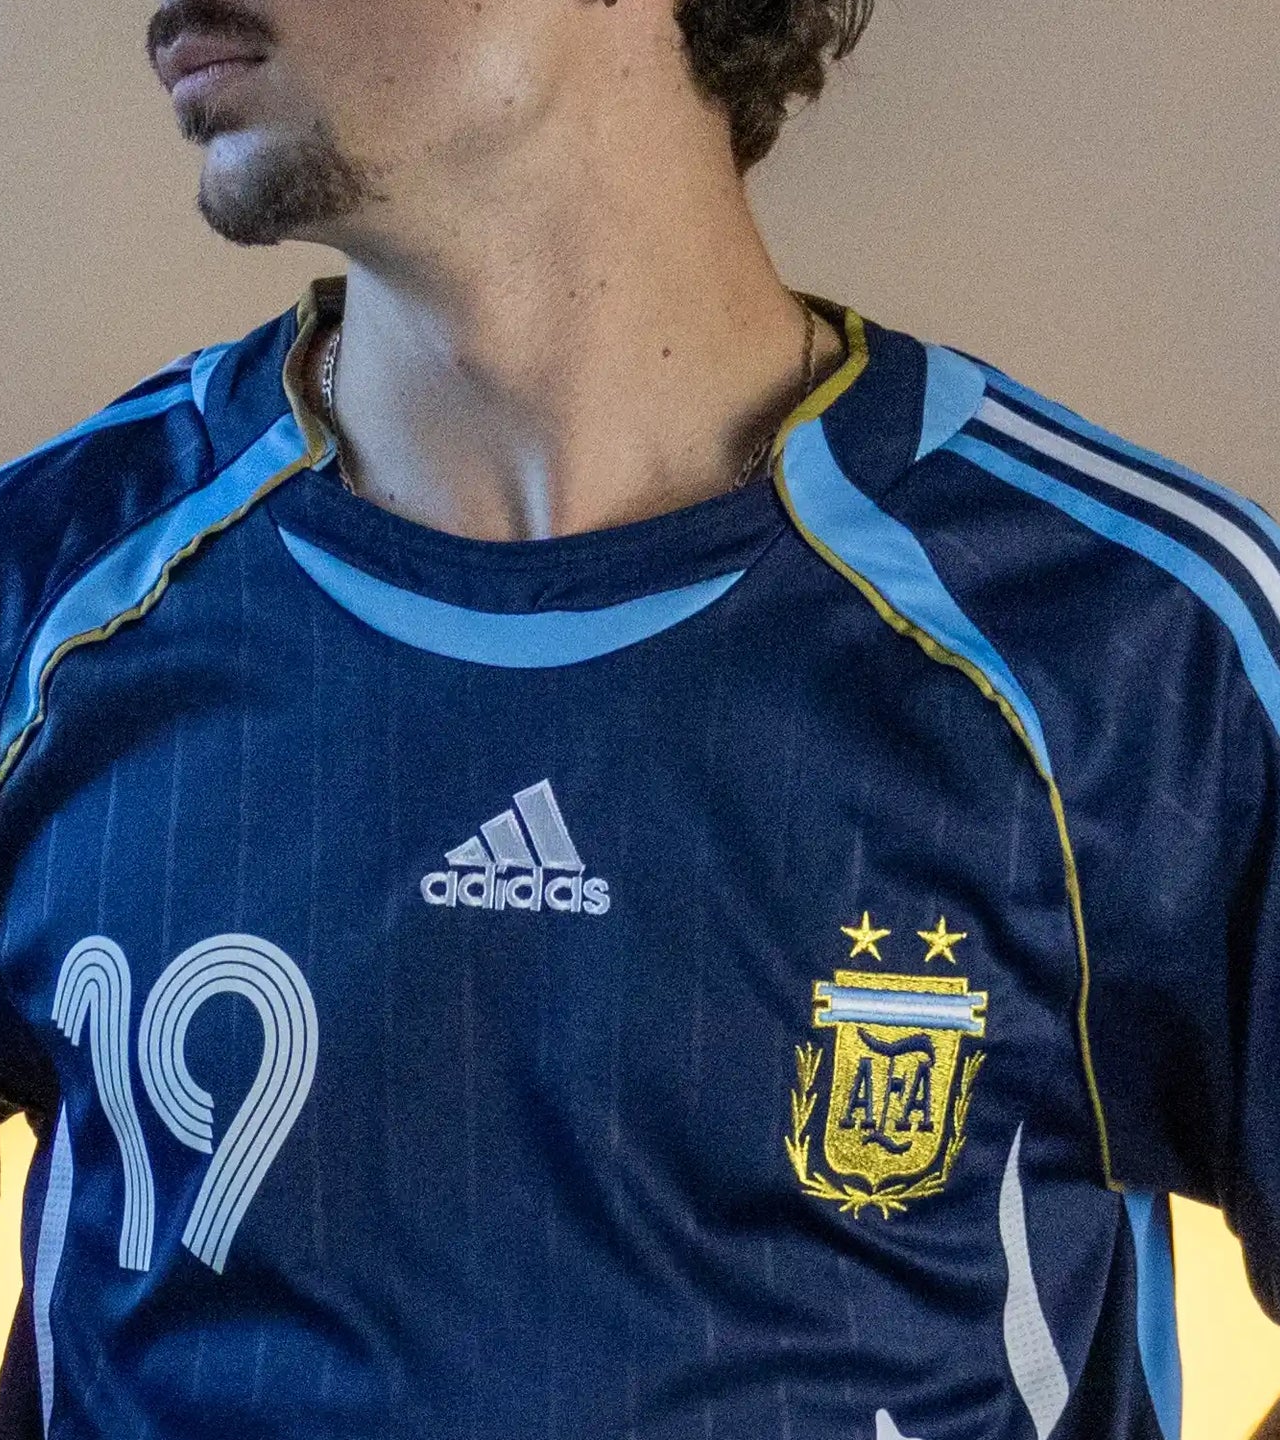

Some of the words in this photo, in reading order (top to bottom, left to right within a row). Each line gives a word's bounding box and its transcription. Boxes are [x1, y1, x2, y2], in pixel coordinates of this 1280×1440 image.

[419, 863, 611, 916] adidas
[51, 932, 320, 1276] 19
[838, 1027, 937, 1157] AFA
